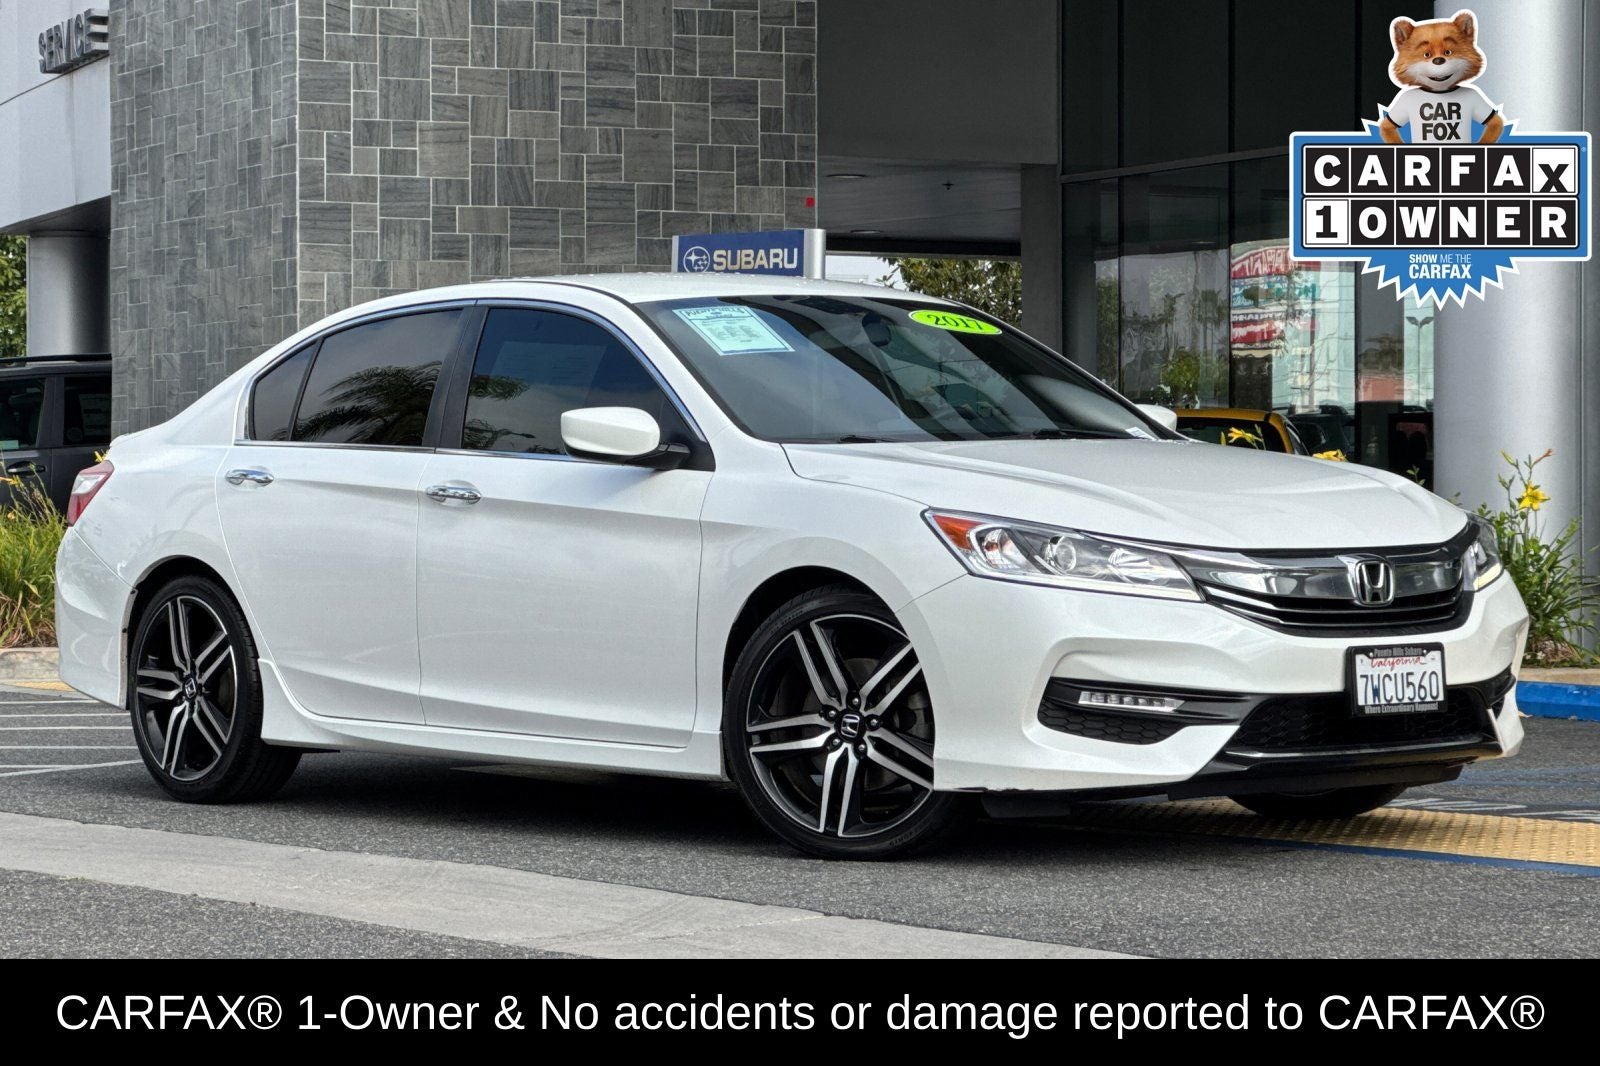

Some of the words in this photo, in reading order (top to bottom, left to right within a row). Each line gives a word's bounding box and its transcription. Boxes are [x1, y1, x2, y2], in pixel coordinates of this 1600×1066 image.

[39, 8, 109, 74] SERVICE
[713, 248, 798, 271] SUBARU
[927, 314, 983, 330] 2017
[1370, 656, 1424, 672] California
[1360, 670, 1440, 704] 7WCU560
